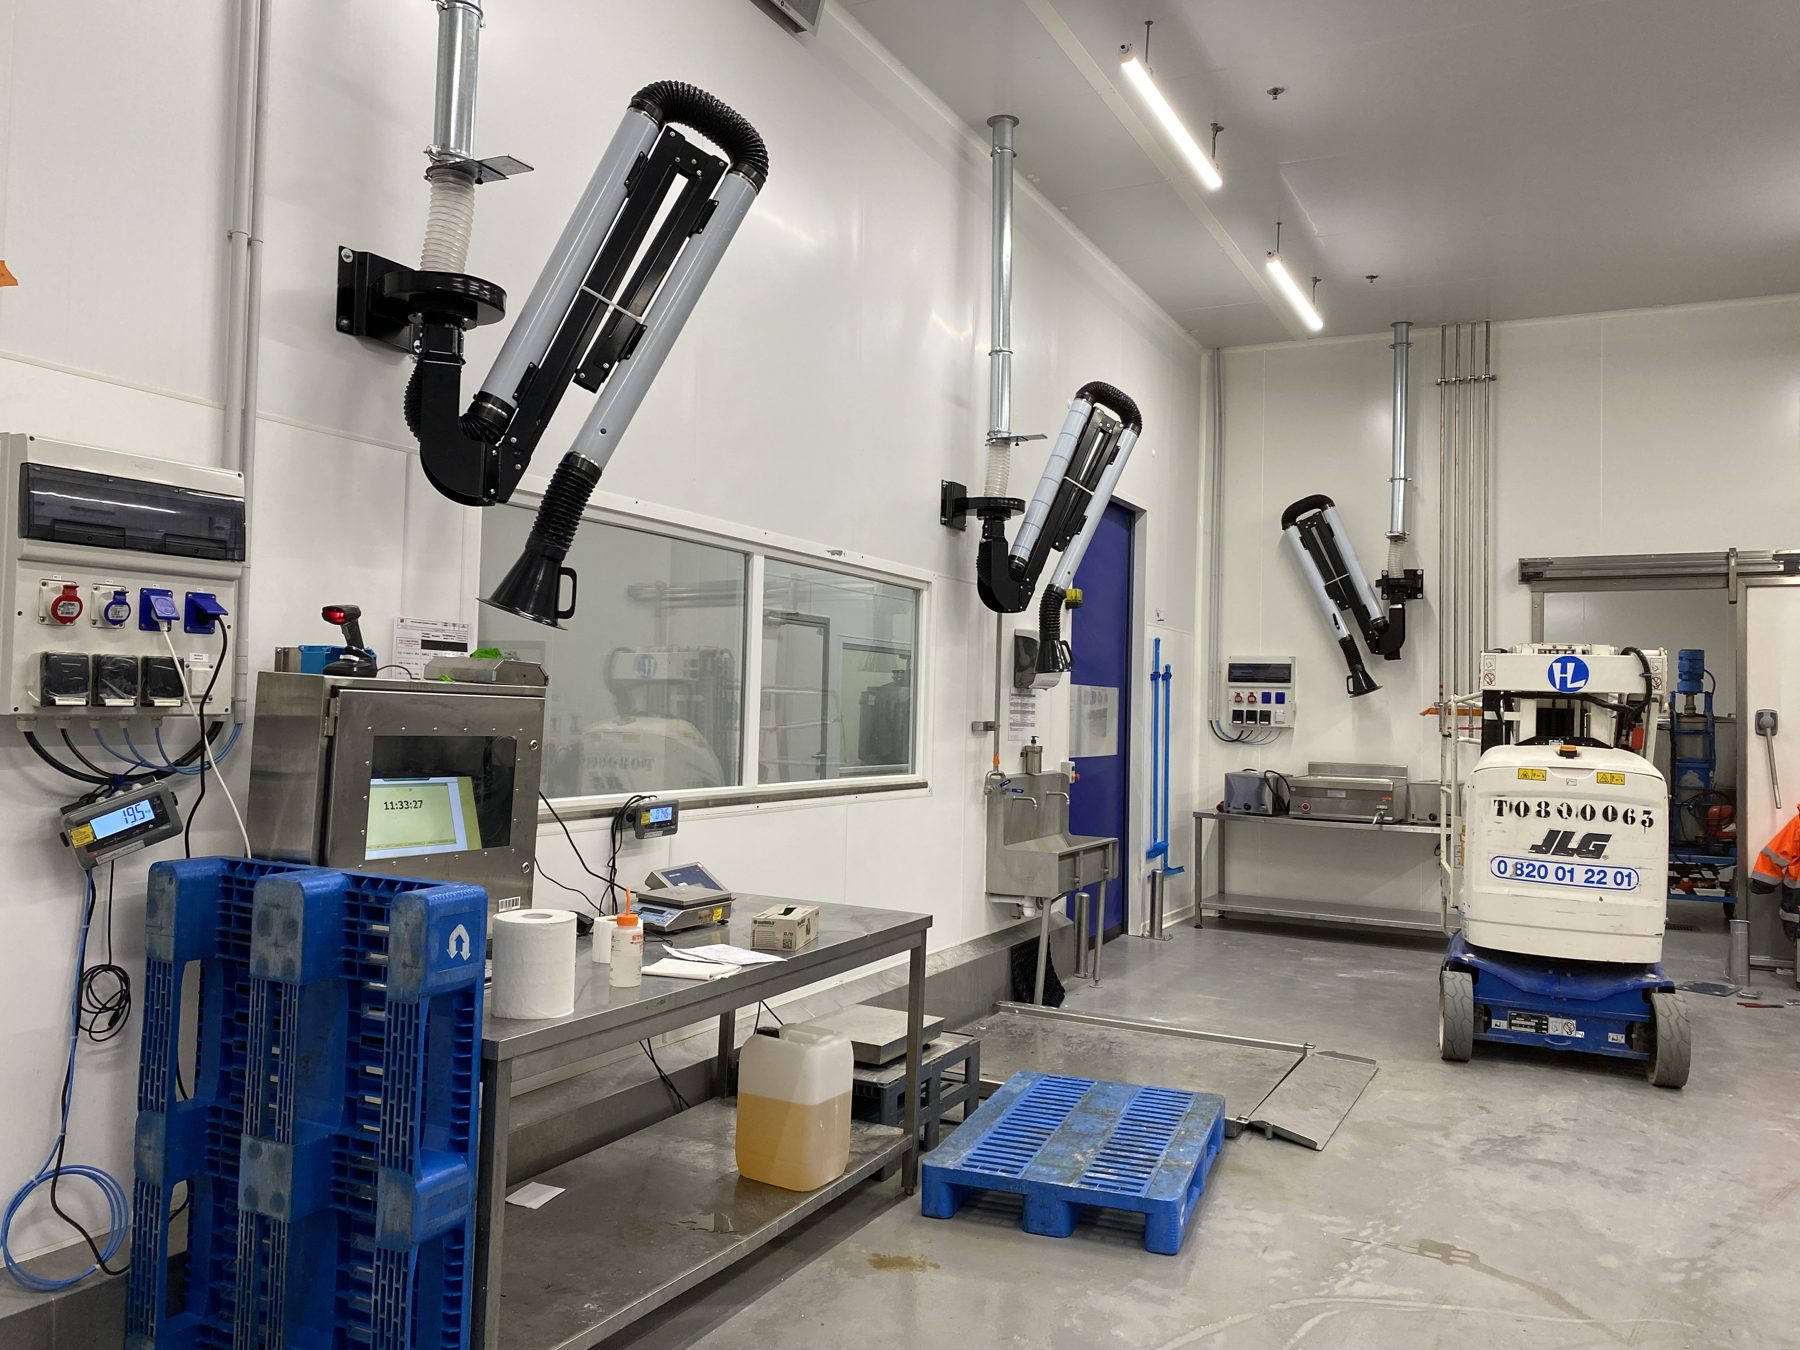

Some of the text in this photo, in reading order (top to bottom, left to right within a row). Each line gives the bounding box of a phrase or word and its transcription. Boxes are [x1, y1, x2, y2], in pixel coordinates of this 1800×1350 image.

[383, 799, 423, 811] 11:33:27
[1528, 829, 1613, 860] JLG
[1497, 859, 1633, 888] 0 820 01 22 01
